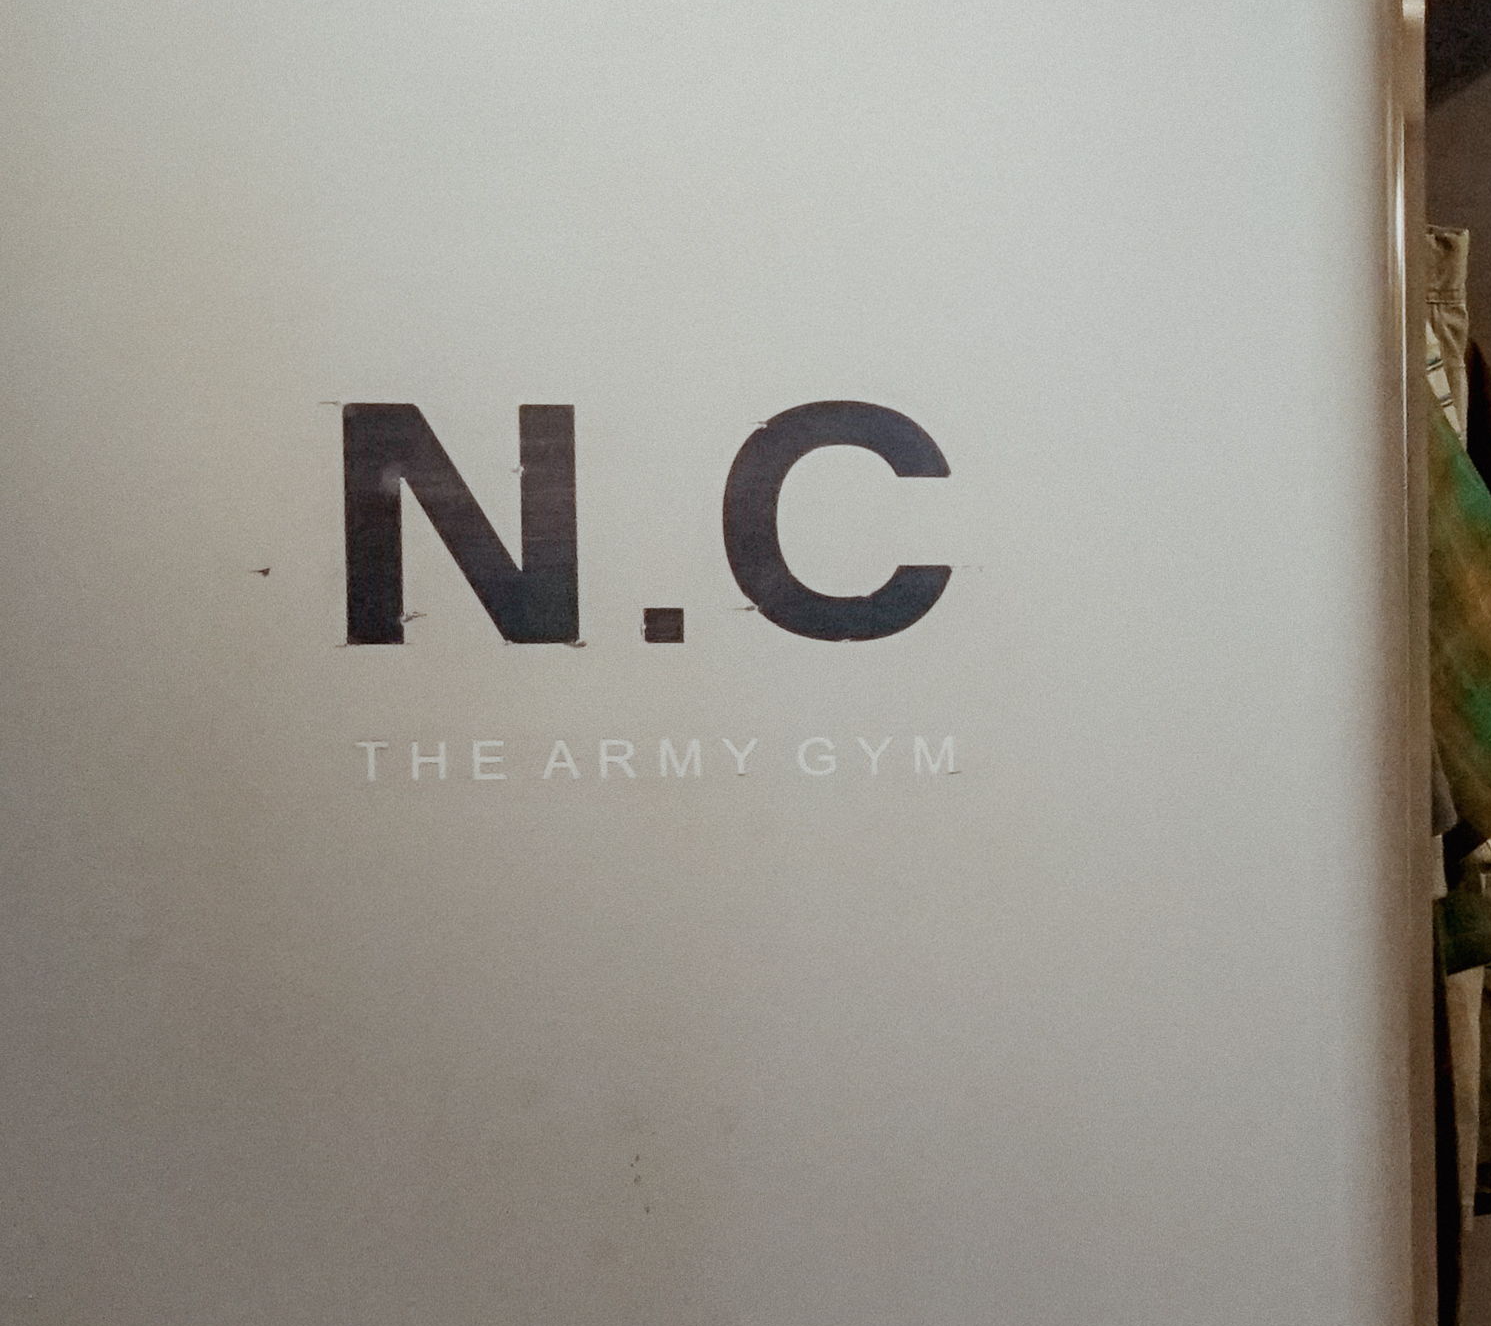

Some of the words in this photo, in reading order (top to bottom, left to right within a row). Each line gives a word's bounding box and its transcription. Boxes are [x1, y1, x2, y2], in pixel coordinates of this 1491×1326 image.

[343, 401, 952, 645] N.C
[355, 738, 507, 782] THE
[541, 737, 759, 779] ARMY
[795, 734, 957, 777] GYM
